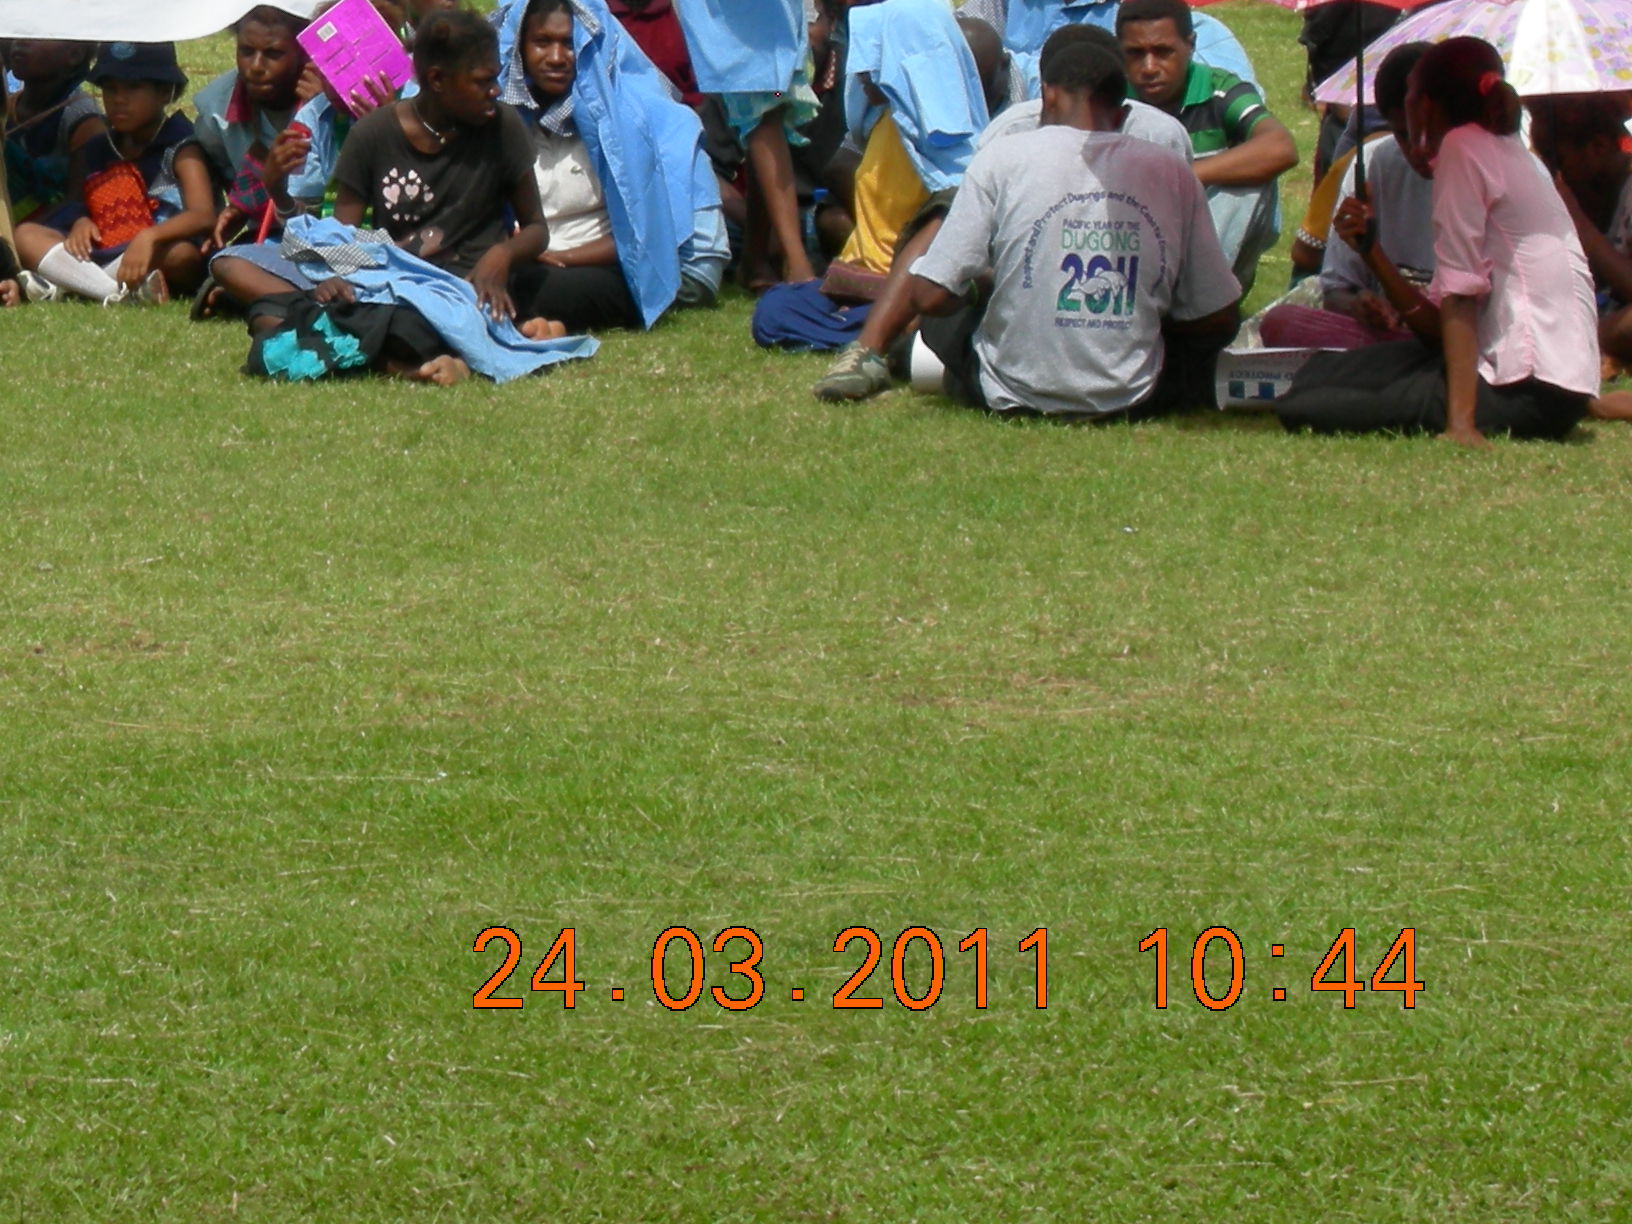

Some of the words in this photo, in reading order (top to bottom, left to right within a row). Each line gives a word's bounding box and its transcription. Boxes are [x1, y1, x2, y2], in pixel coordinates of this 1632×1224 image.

[1033, 197, 1068, 230] Protect
[1062, 228, 1140, 251] DUGONG
[1057, 252, 1139, 317] 2011
